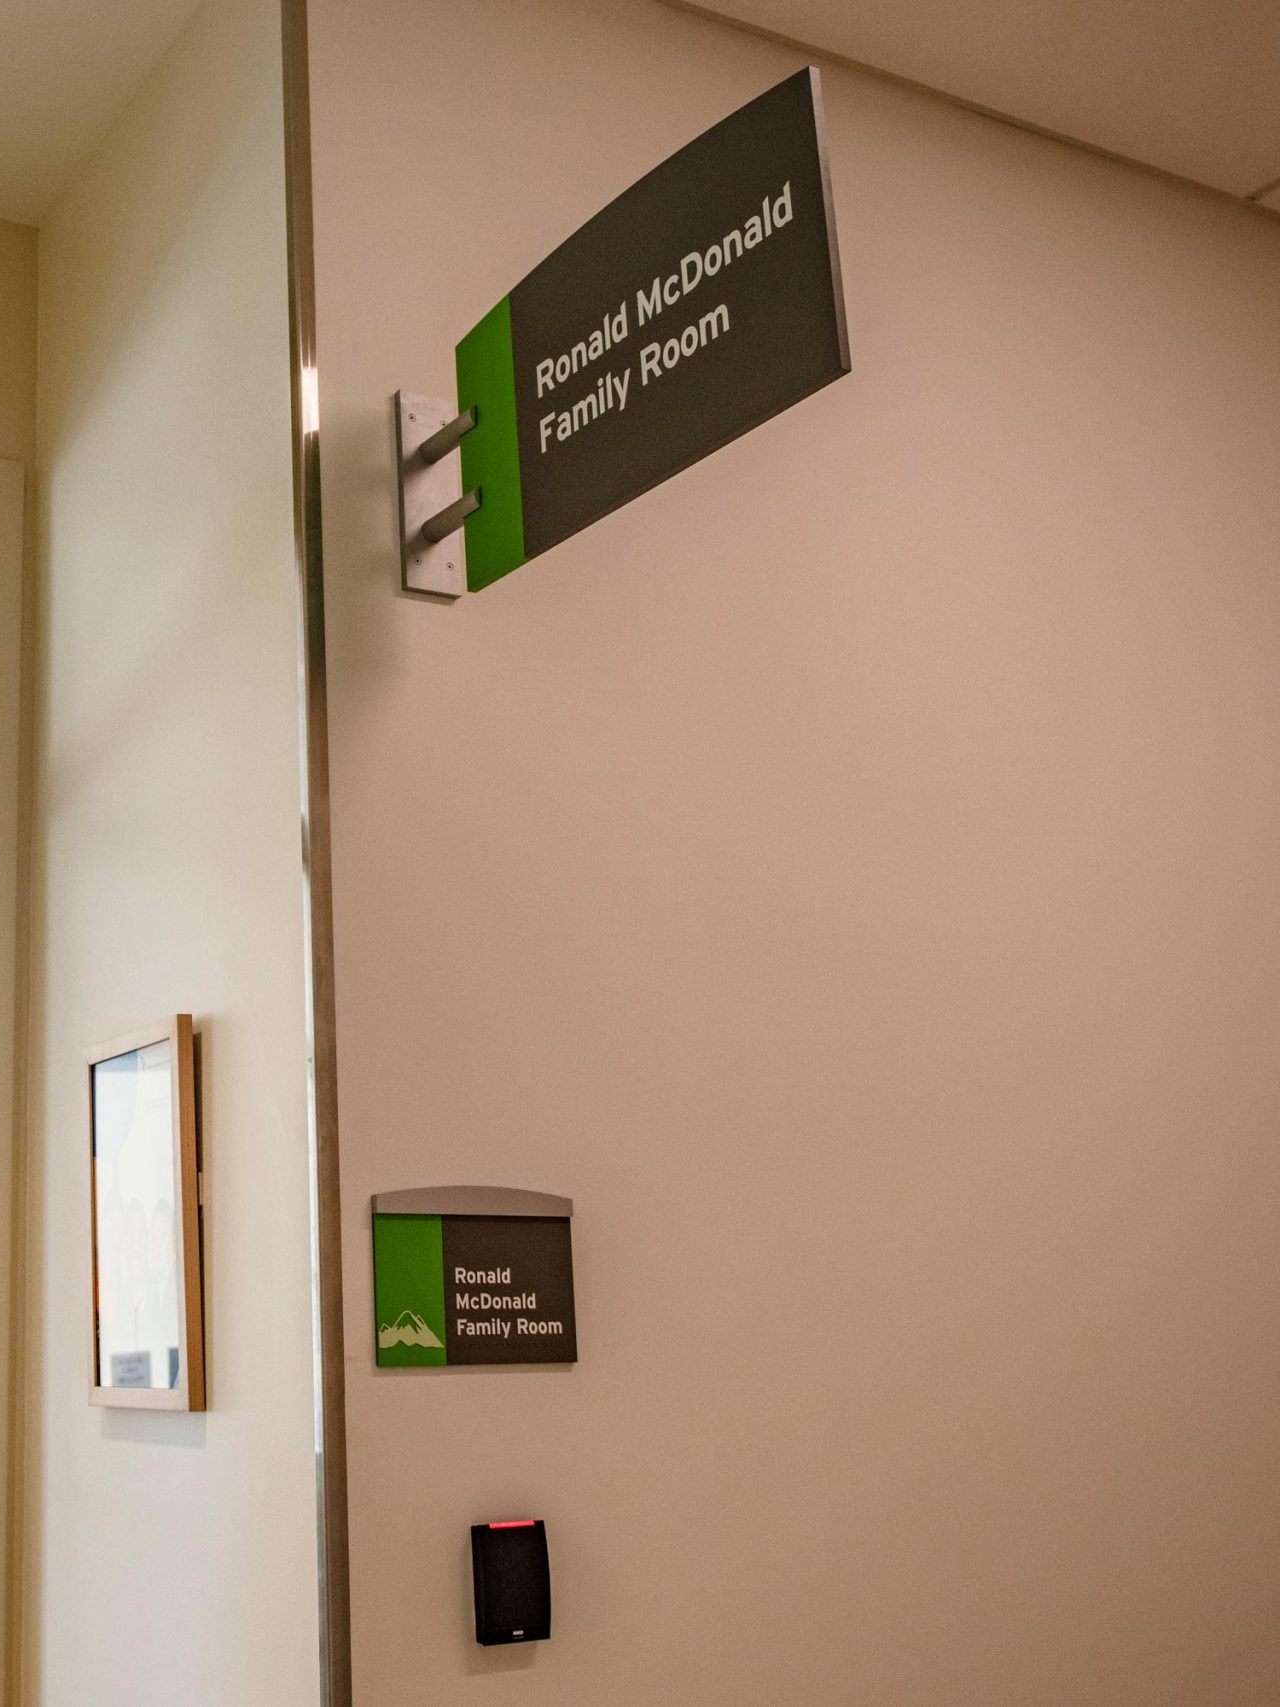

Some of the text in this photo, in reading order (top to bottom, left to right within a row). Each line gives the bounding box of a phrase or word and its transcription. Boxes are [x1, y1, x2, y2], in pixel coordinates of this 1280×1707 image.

[536, 180, 794, 399] Ronald McDonald
[539, 304, 731, 454] Family Room
[454, 1267, 511, 1284] Ronald
[455, 1292, 537, 1310] McDonald
[456, 1317, 563, 1339] Family Room
